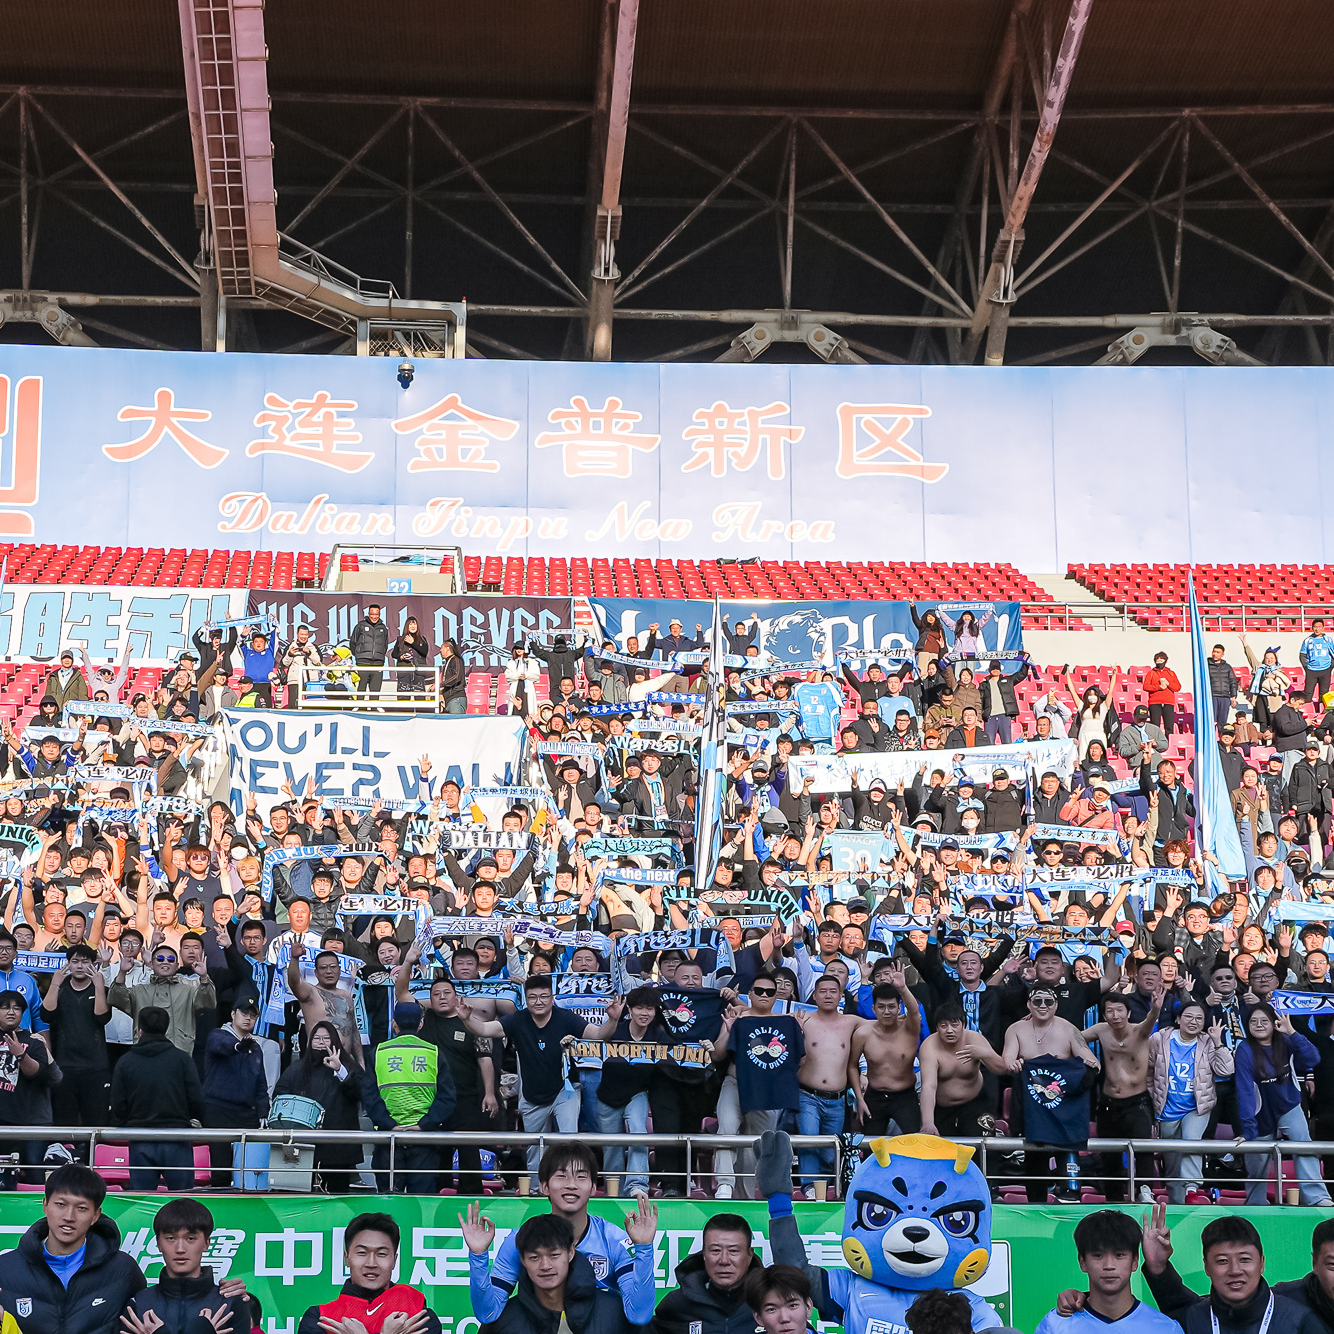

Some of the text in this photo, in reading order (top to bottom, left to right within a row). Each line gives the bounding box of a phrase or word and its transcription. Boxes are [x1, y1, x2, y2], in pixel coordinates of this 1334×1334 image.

[102, 386, 950, 484] 大连金普新区
[217, 492, 396, 535] Dalian
[585, 500, 693, 542] New
[712, 500, 836, 544] Area
[70, 766, 155, 781] 大连 必胜
[450, 832, 529, 850] DALIAN
[621, 867, 677, 883] the next
[1026, 867, 1072, 885] 大连
[1092, 864, 1137, 881] 必胜
[748, 886, 798, 921] UNION
[749, 1027, 787, 1042] DALIAN
[673, 1043, 713, 1062] UNIO
[386, 1054, 429, 1075] 安保
[1174, 1062, 1190, 1078] 12
